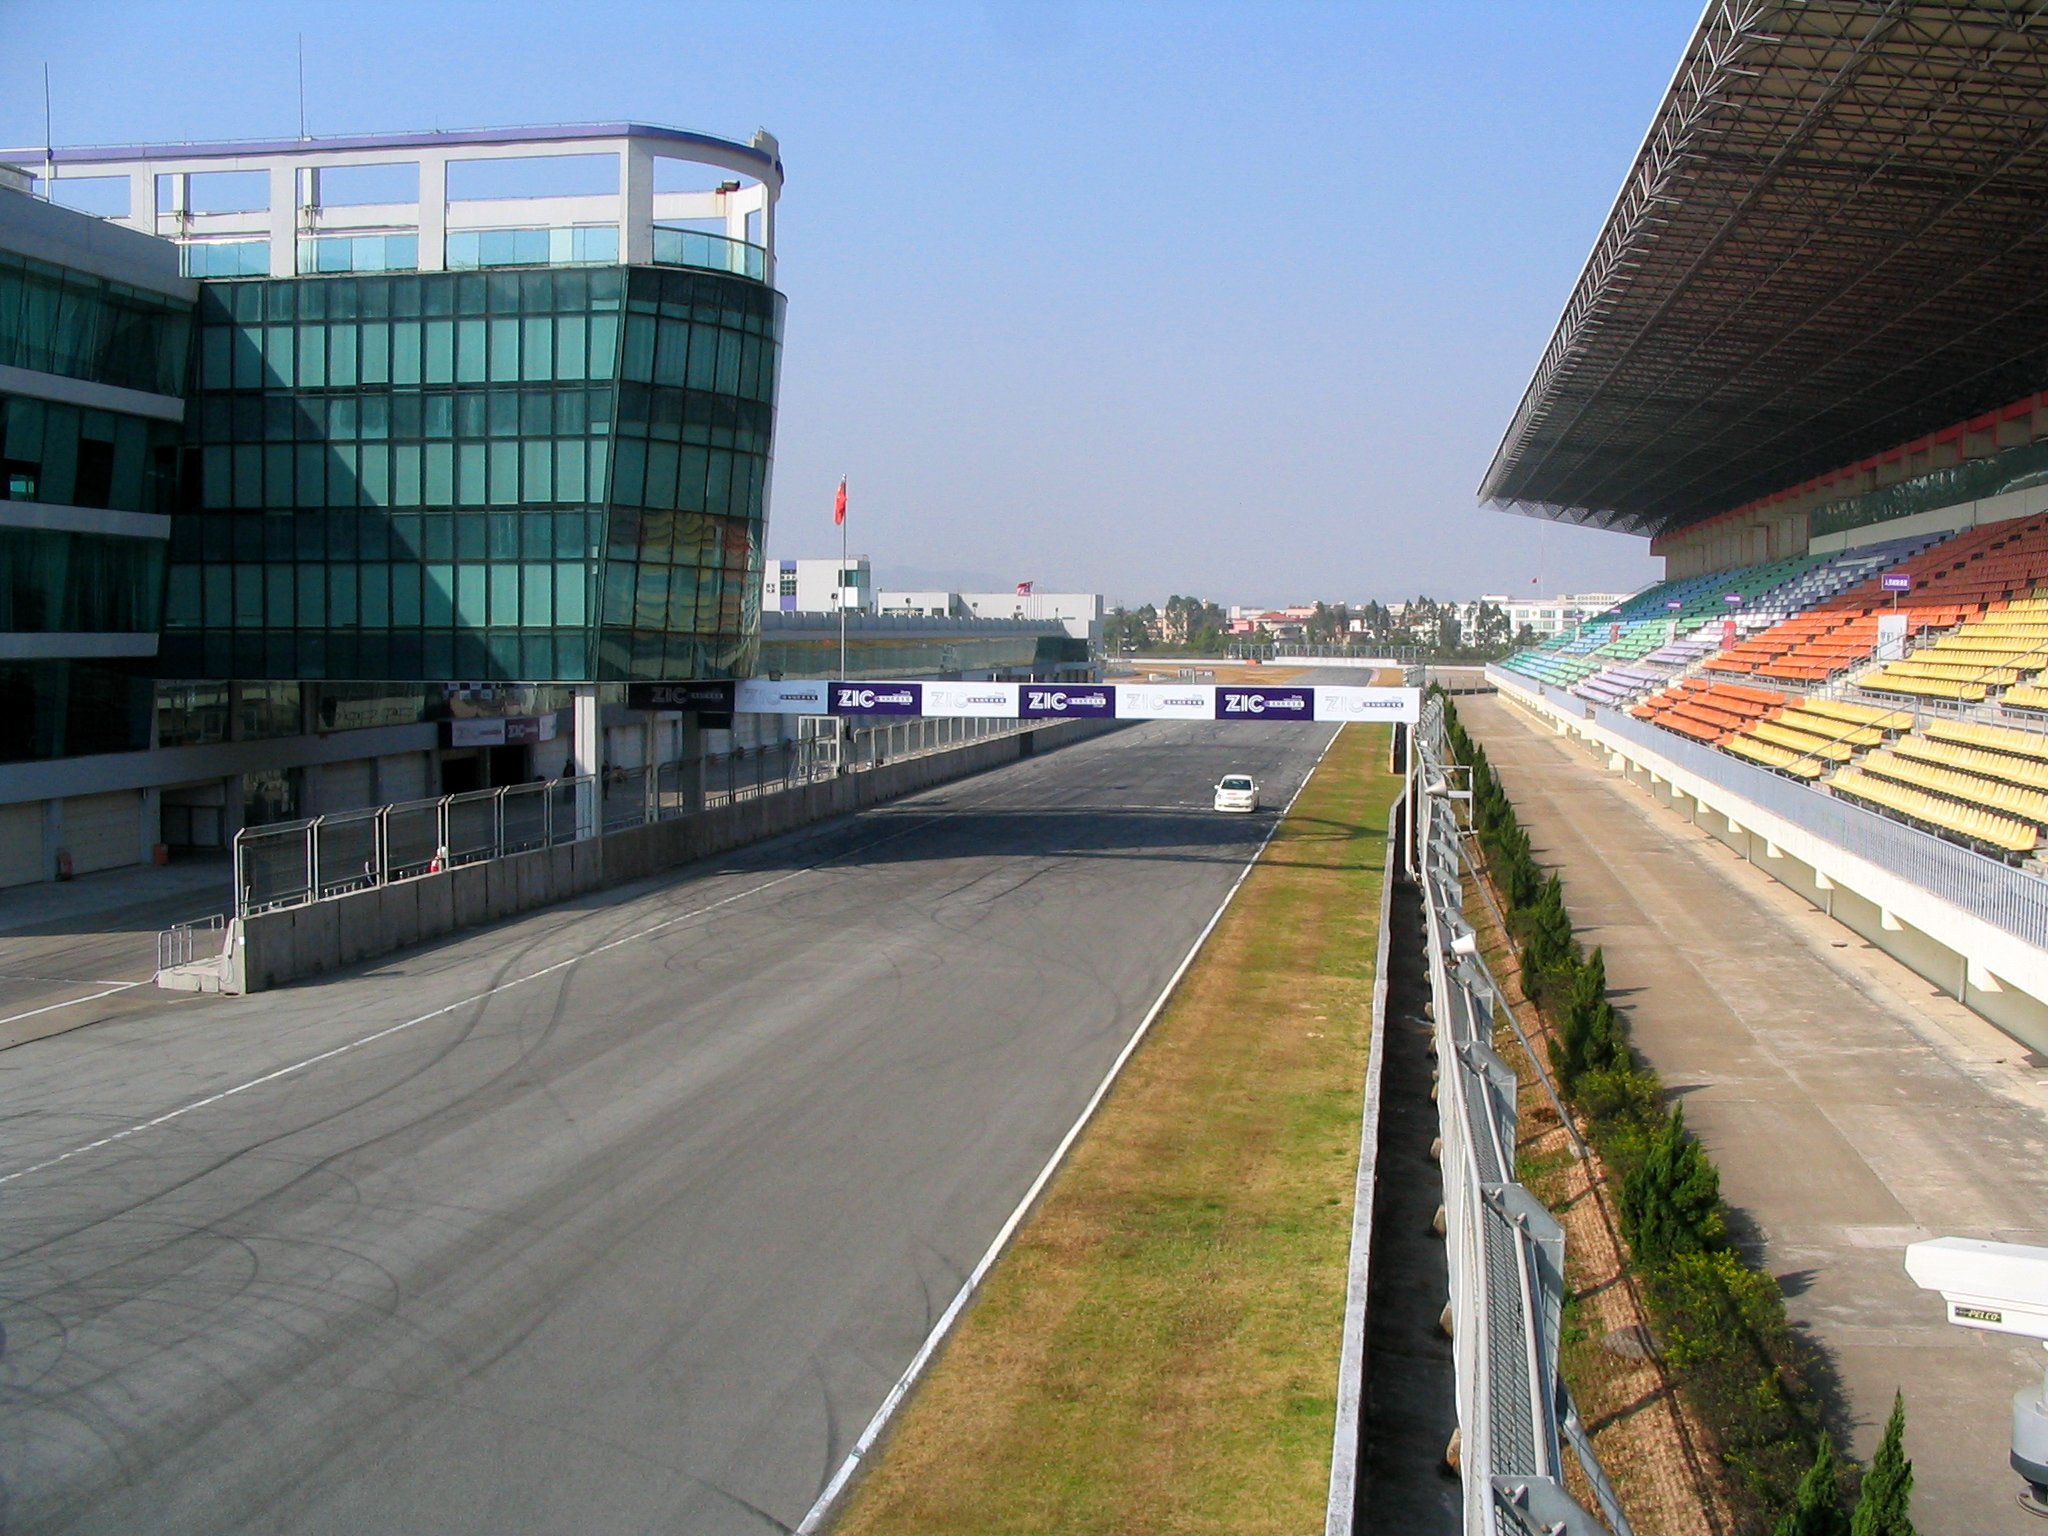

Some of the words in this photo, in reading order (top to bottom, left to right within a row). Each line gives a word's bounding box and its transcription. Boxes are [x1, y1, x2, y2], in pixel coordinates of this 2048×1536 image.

[838, 690, 875, 708] ZIC
[1028, 692, 1067, 711] ZIC
[1225, 694, 1265, 713] ZIC
